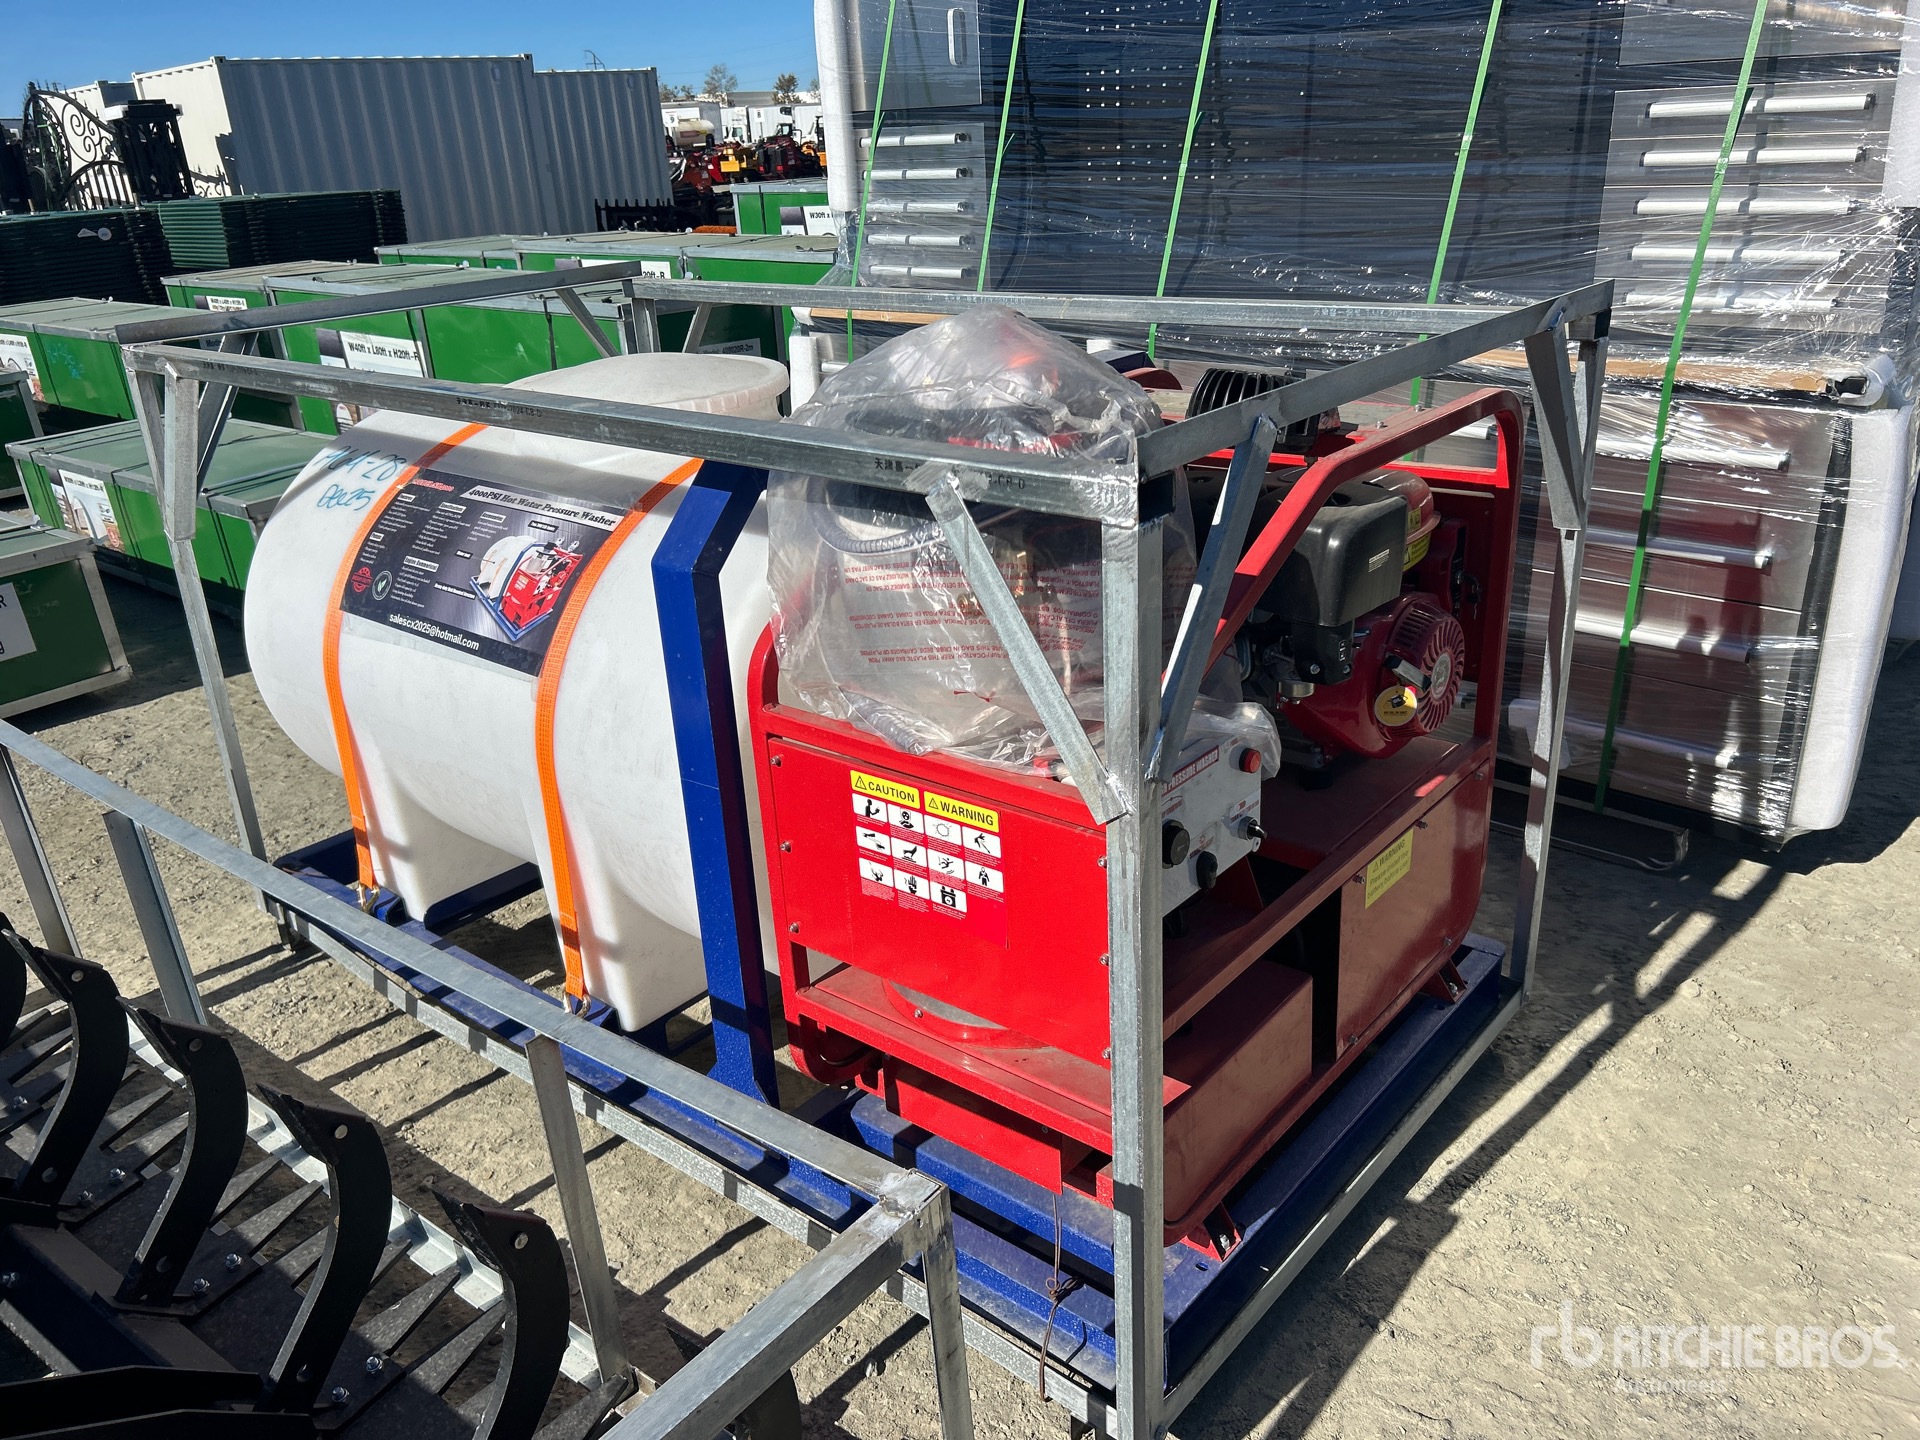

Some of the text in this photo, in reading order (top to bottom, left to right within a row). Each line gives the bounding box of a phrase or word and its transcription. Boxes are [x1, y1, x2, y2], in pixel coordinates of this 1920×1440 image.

[348, 342, 366, 353] W40ft
[372, 346, 387, 356] L80ft
[469, 489, 616, 527] 4000PSI Hot Water Pressure Washer
[389, 614, 480, 650] salescx2025@hotmail.com
[868, 780, 915, 803] CAUTION
[940, 800, 994, 826] WARNING
[1380, 839, 1405, 867] WARNING
